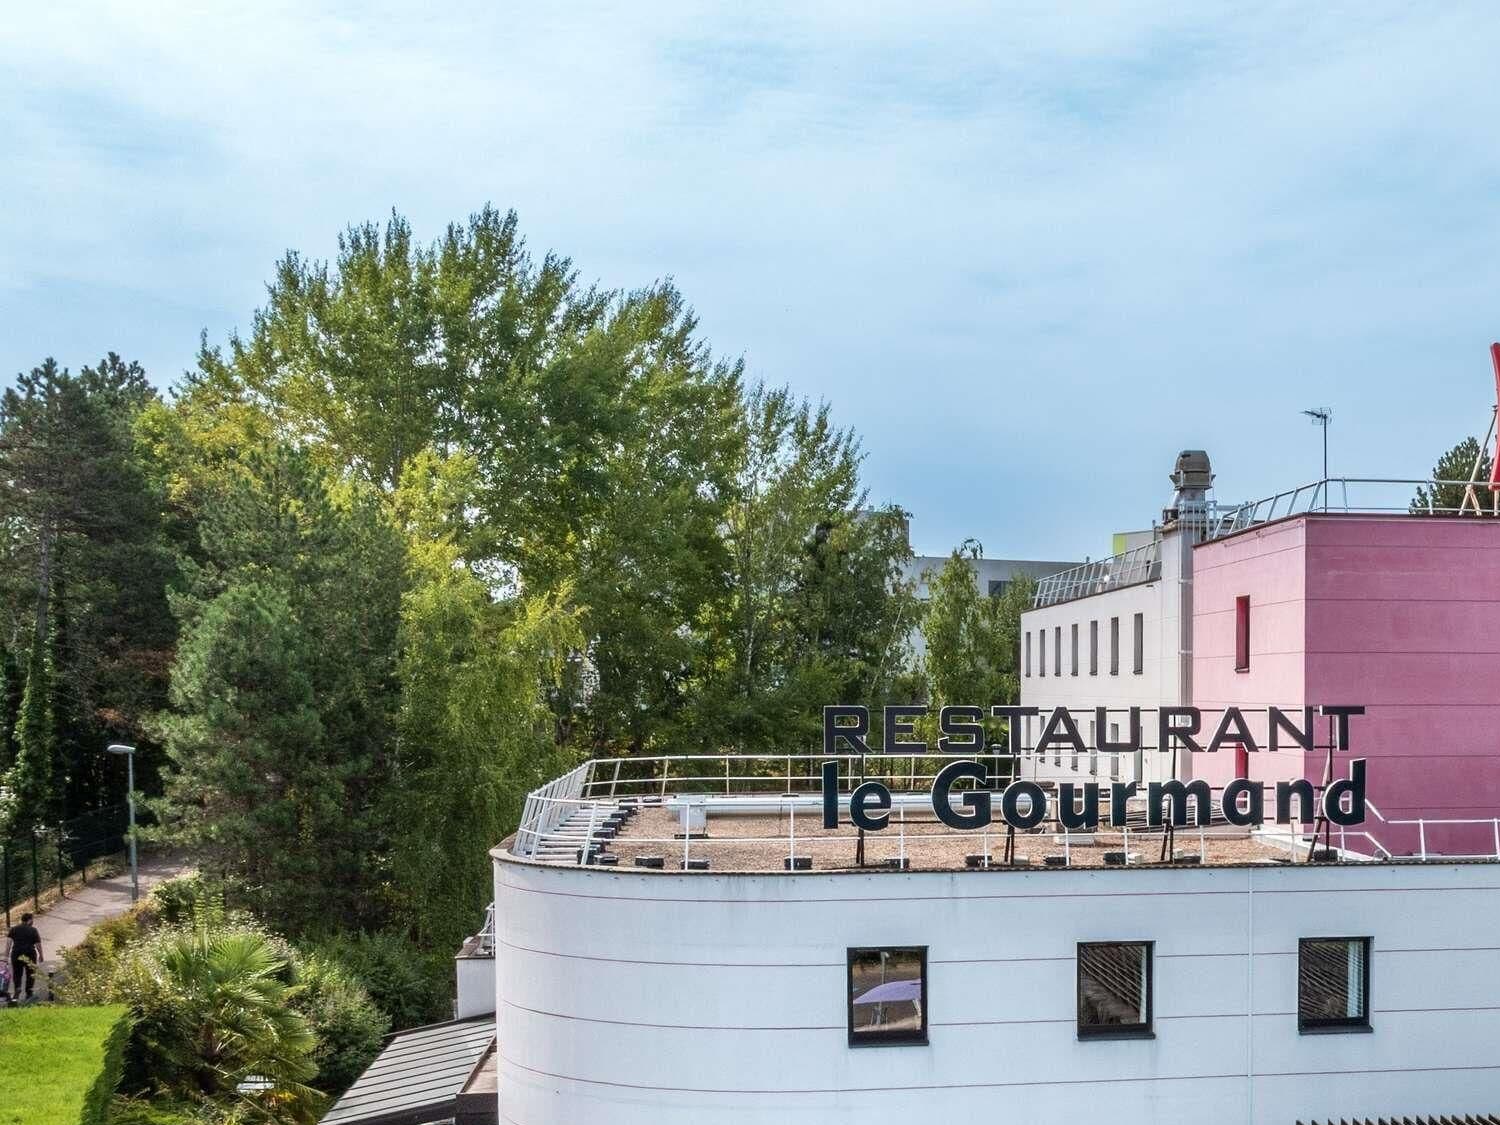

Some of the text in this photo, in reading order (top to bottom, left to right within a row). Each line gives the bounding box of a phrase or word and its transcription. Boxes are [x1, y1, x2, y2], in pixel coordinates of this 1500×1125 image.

[822, 704, 1366, 755] RESTAURANT
[821, 758, 1367, 831] le Gourmand
